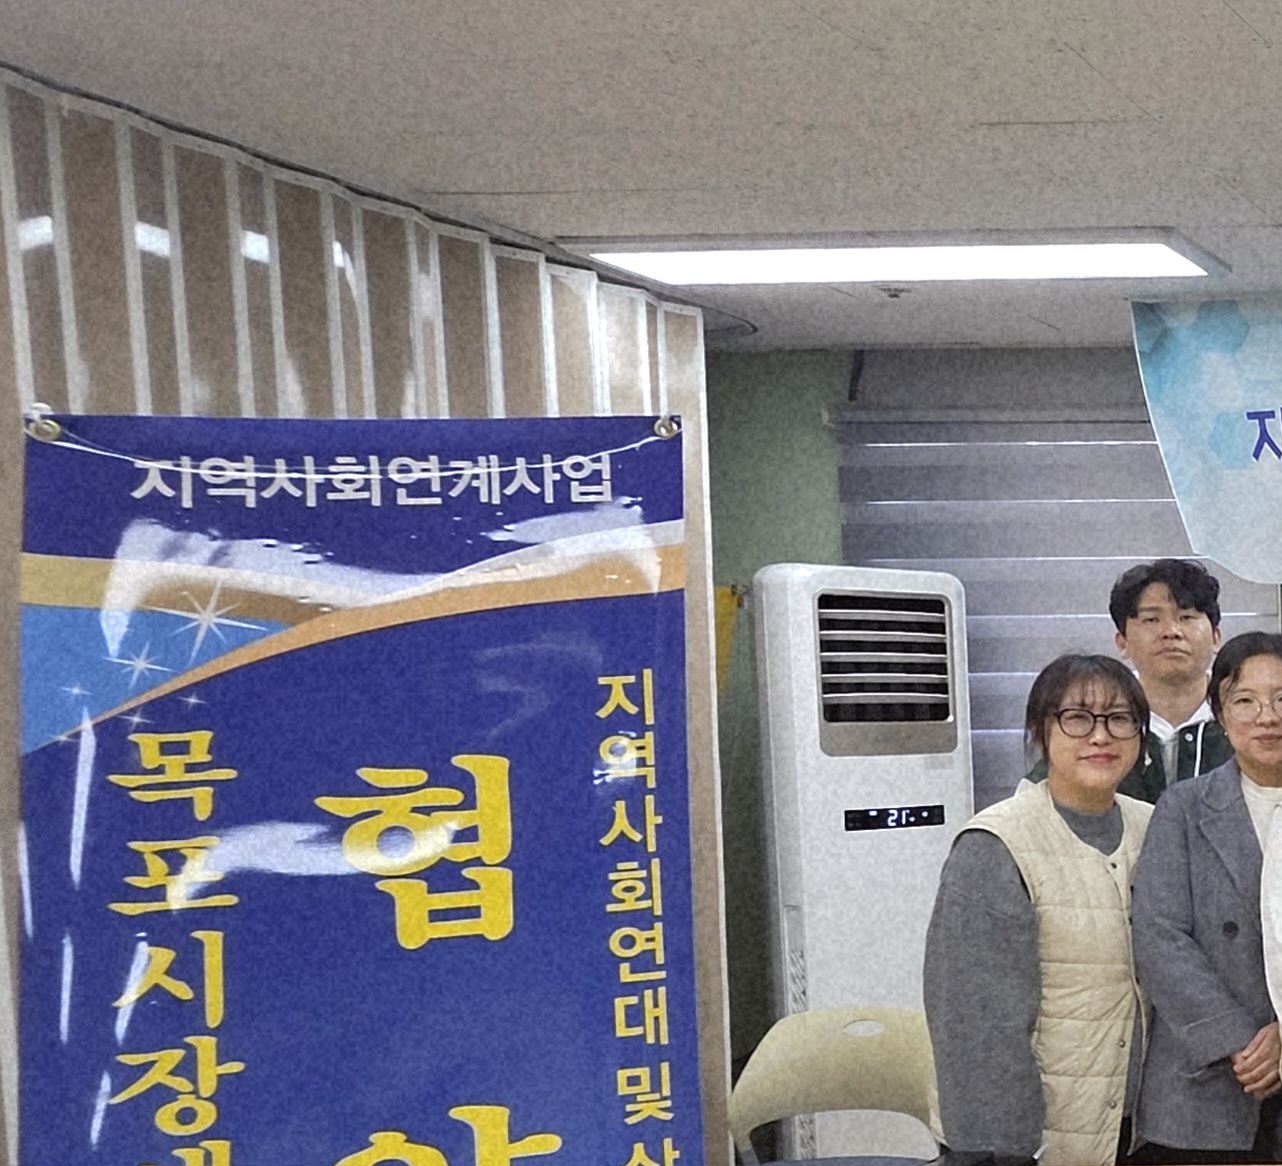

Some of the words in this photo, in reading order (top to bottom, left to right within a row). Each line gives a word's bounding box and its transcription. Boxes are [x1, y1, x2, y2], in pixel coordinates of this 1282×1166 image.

[131, 452, 614, 508] 지역사회연계사업
[596, 669, 670, 1045] 지역사회연대
[616, 1062, 674, 1125] 및
